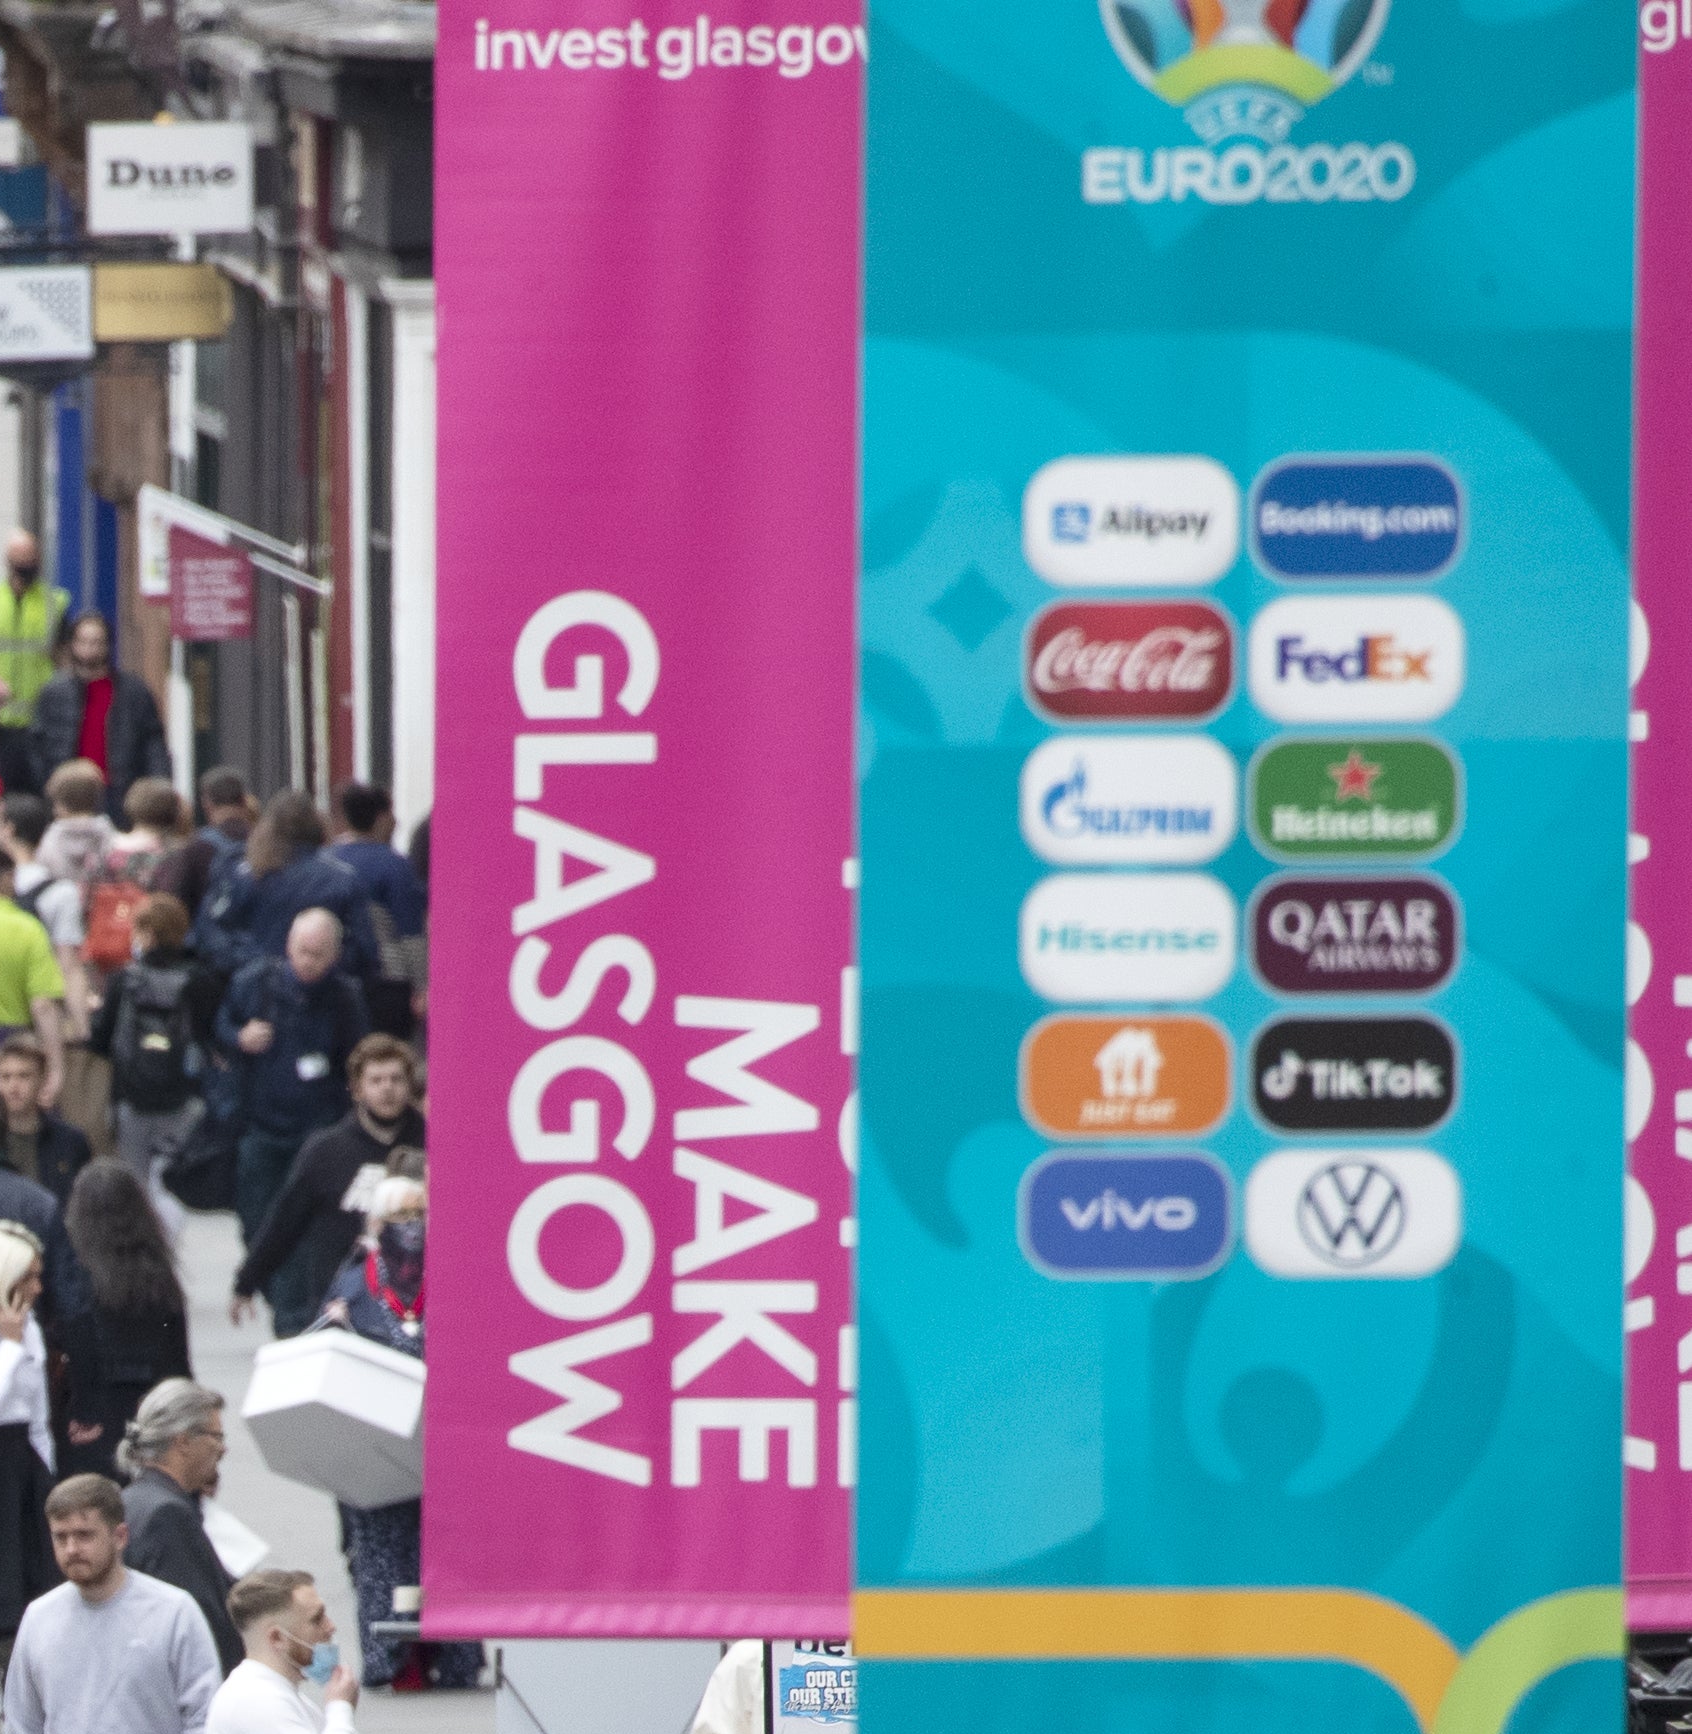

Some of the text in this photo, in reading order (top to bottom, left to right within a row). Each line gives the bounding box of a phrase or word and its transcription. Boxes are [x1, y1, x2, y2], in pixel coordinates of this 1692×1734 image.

[474, 18, 650, 71] invest
[107, 159, 236, 188] Dune
[1101, 504, 1210, 539] Alipay
[1261, 501, 1454, 542] Booking.com
[1276, 634, 1432, 683] FedEx
[1272, 802, 1438, 841] Heineken
[1038, 921, 1220, 953] Hisense
[1269, 900, 1438, 953] QATAR
[1308, 946, 1441, 973] AIRWAYS
[507, 588, 661, 1487] GLASGOW
[1308, 1057, 1444, 1100] TikTok
[1060, 1188, 1198, 1231] vivo
[670, 995, 820, 1488] MAKE
[789, 1688, 821, 1705] OUR
[806, 1670, 838, 1687] OUR
